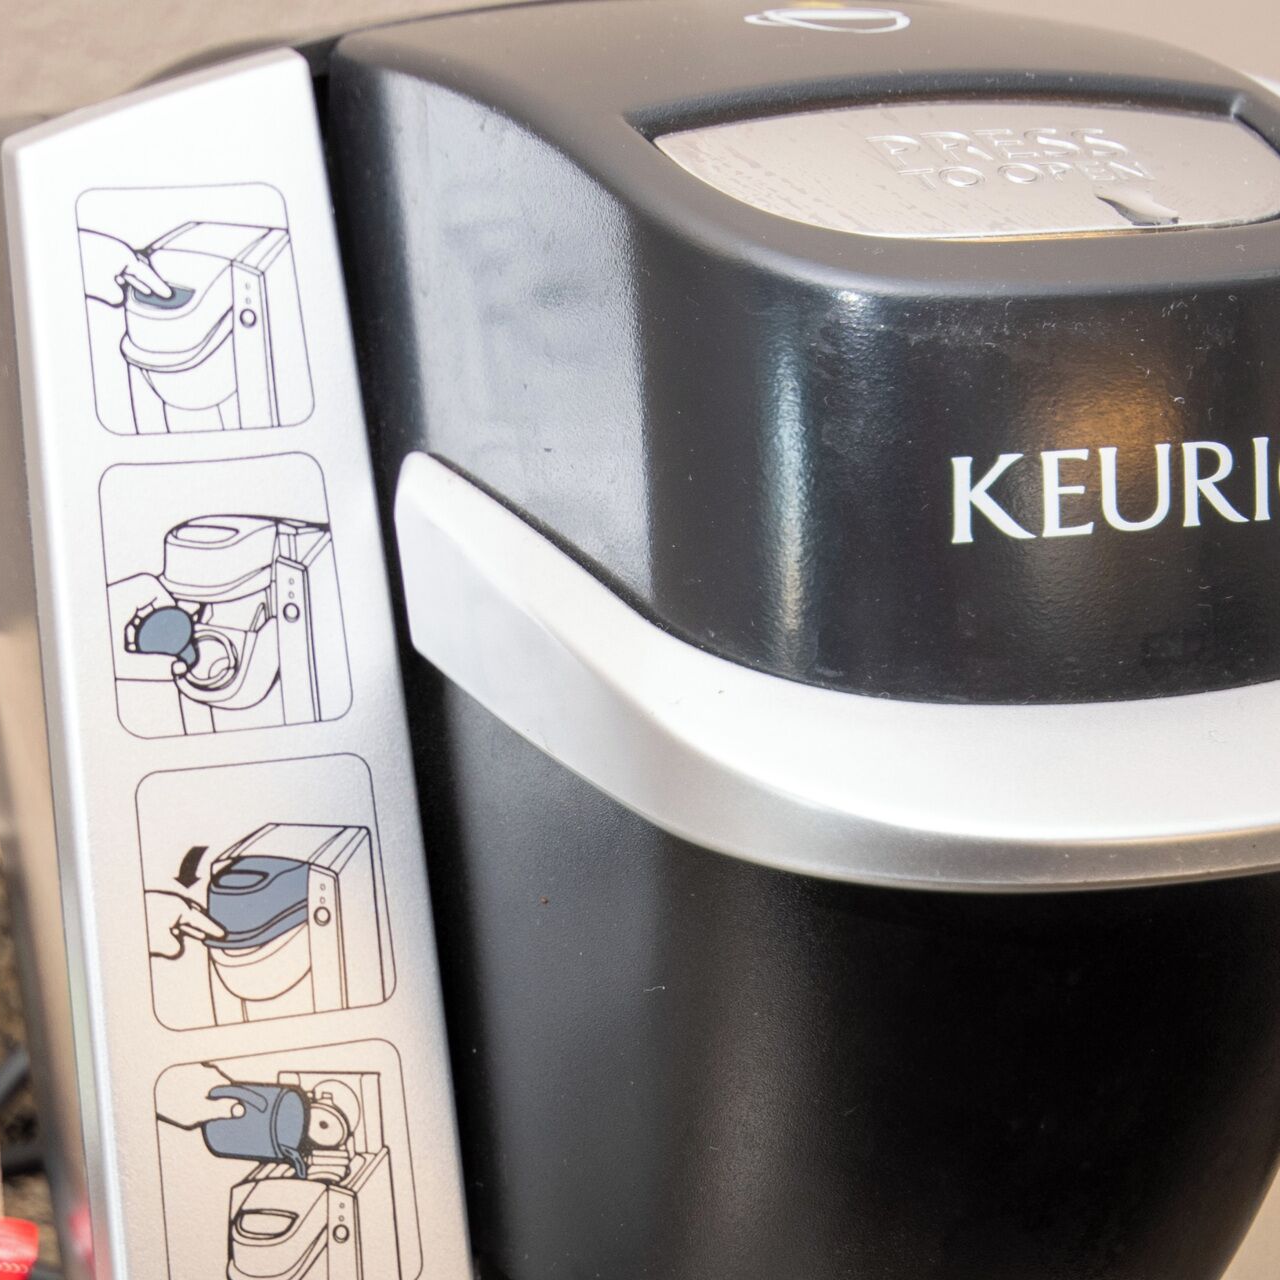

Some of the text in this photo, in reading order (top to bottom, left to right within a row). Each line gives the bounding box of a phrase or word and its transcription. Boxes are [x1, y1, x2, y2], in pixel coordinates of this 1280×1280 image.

[864, 127, 1129, 166] PRESS
[897, 160, 1157, 191] TO OPEN
